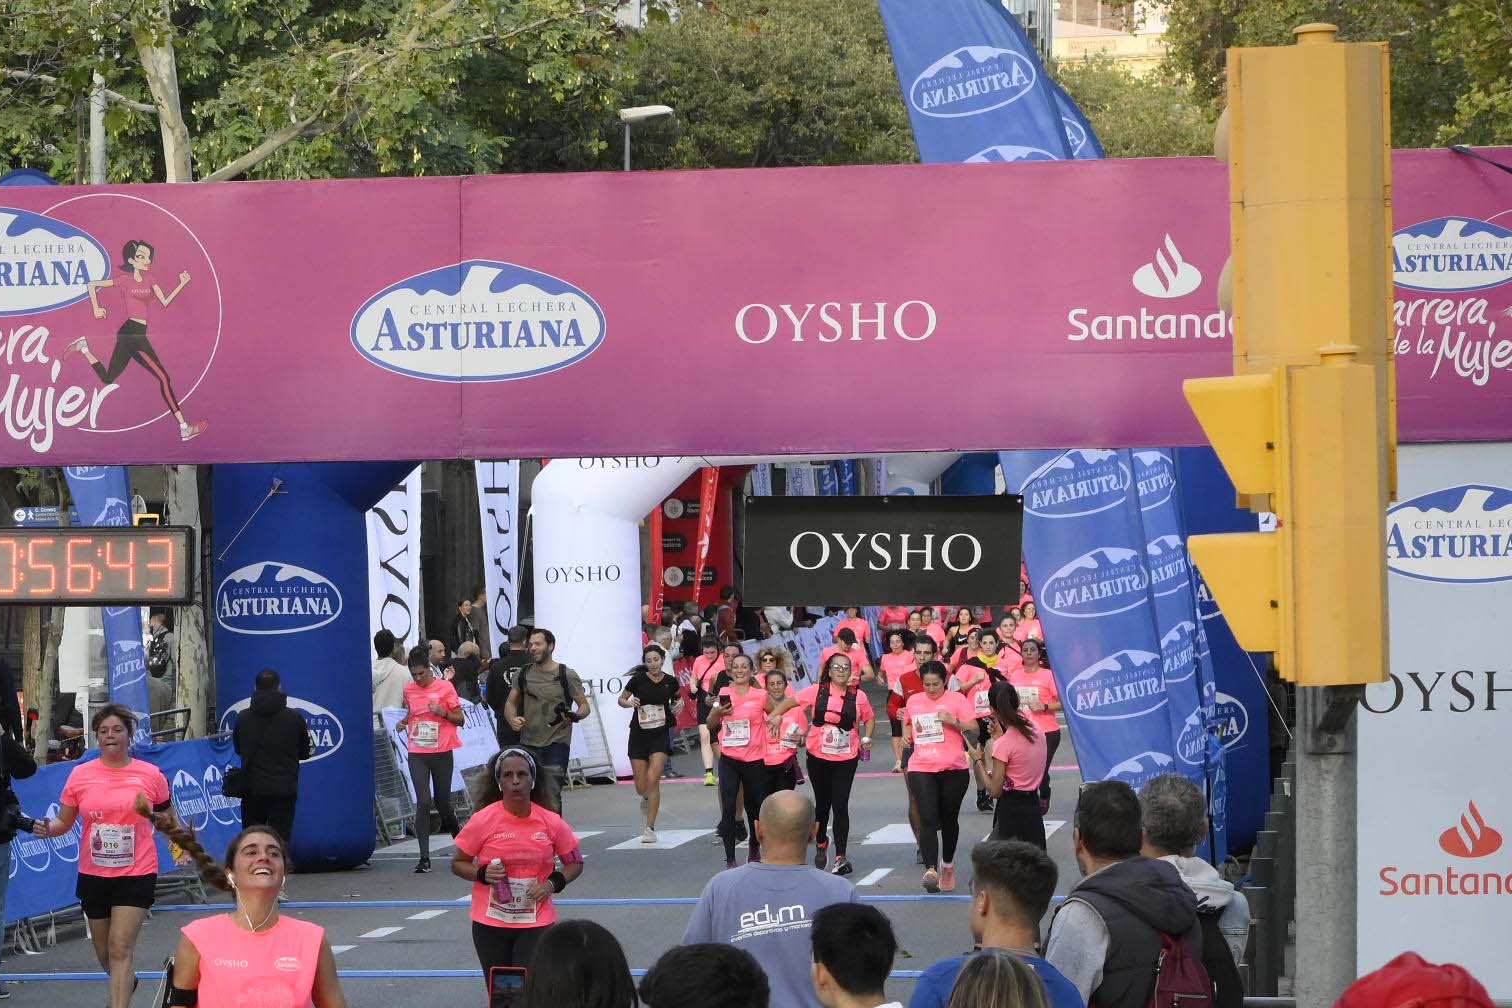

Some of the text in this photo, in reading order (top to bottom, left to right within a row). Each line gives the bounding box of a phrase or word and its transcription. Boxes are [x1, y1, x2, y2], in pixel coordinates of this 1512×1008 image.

[13, 243, 85, 256] LECHERA
[1407, 242, 1459, 251] CENTRAL
[410, 301, 577, 315] CENTRAL LECHERA
[735, 299, 937, 344] OYSHO
[1393, 298, 1488, 327] arrera
[371, 307, 585, 352] ASTURIANA
[1067, 307, 1233, 341] Santand
[1417, 319, 1512, 385] la Muje
[1414, 520, 1481, 529] CENTRAL
[789, 532, 982, 571] OYSHO
[1387, 523, 1512, 559] ASTURIA
[545, 564, 621, 584] OYSHO
[220, 591, 333, 618] ASTURIANA
[232, 586, 330, 596] CENTRAL LECHERA
[1359, 670, 1512, 714] OYSH
[740, 904, 804, 928] edym
